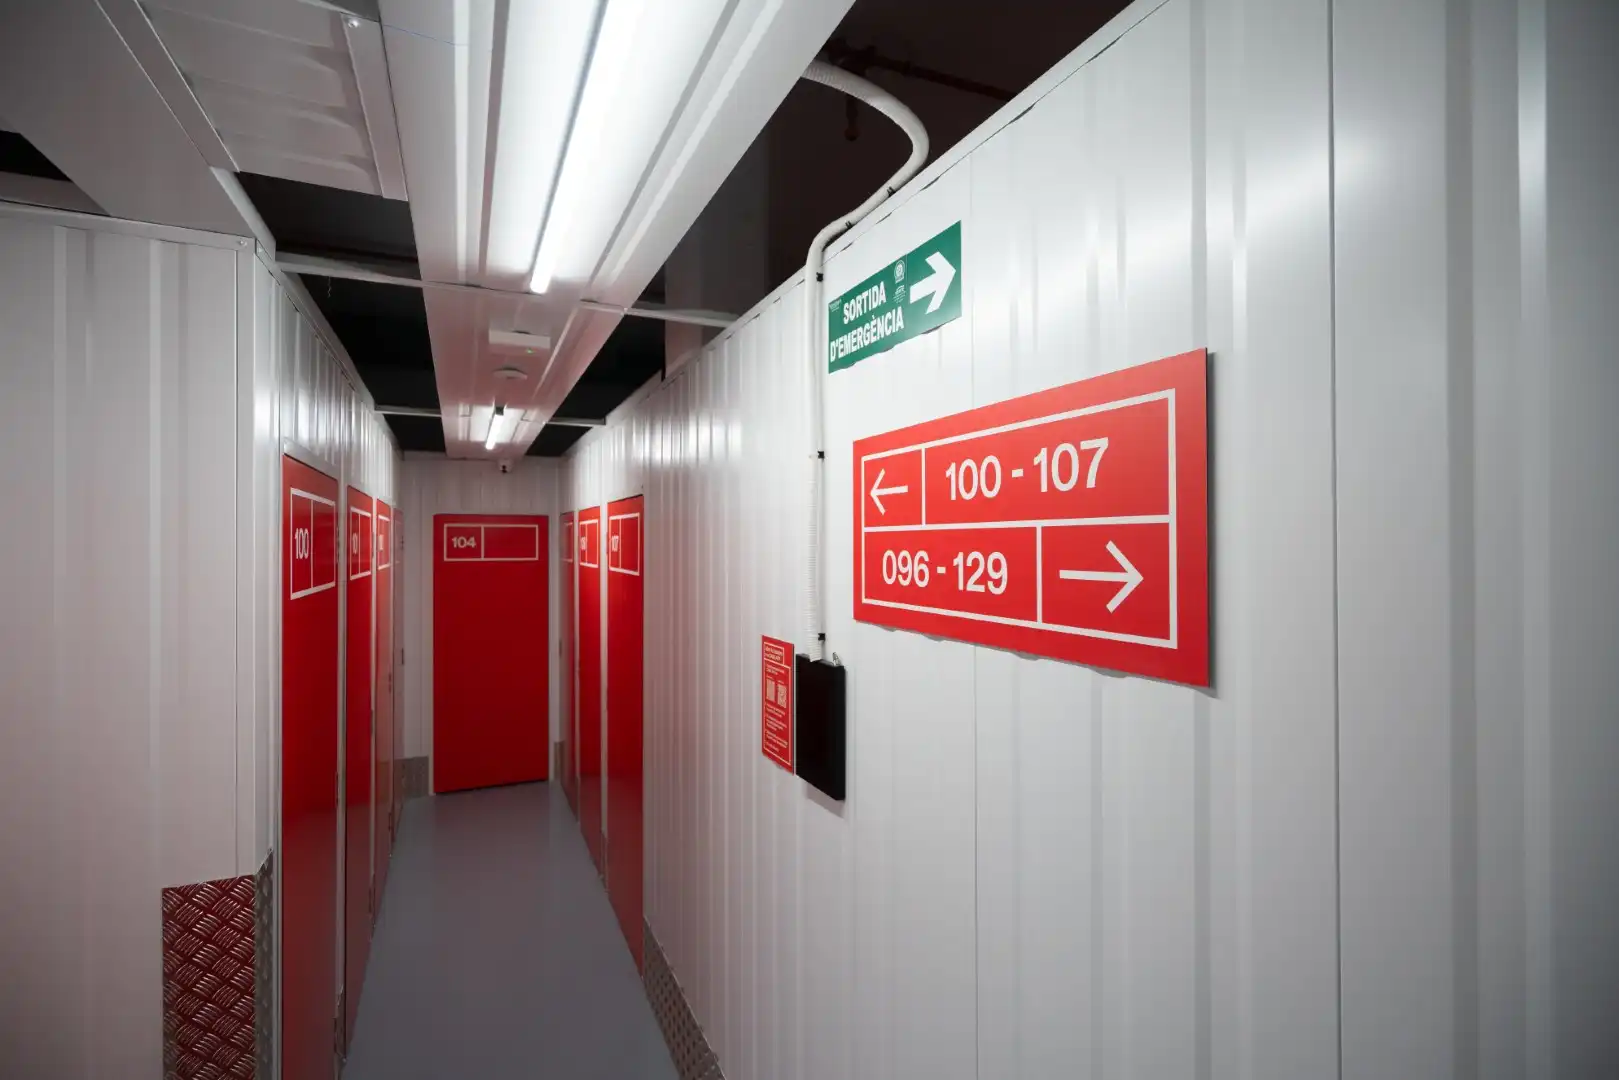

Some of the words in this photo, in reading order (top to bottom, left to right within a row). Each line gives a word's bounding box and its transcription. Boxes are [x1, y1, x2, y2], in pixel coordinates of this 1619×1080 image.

[843, 281, 887, 325] SORTIDA
[830, 306, 905, 363] D'EMERGÈNCIA
[945, 455, 1002, 501] 100
[1033, 436, 1109, 493] 107
[294, 528, 310, 560] 100
[451, 536, 477, 549] 104
[882, 550, 930, 588] 096
[952, 551, 1008, 595] 129
